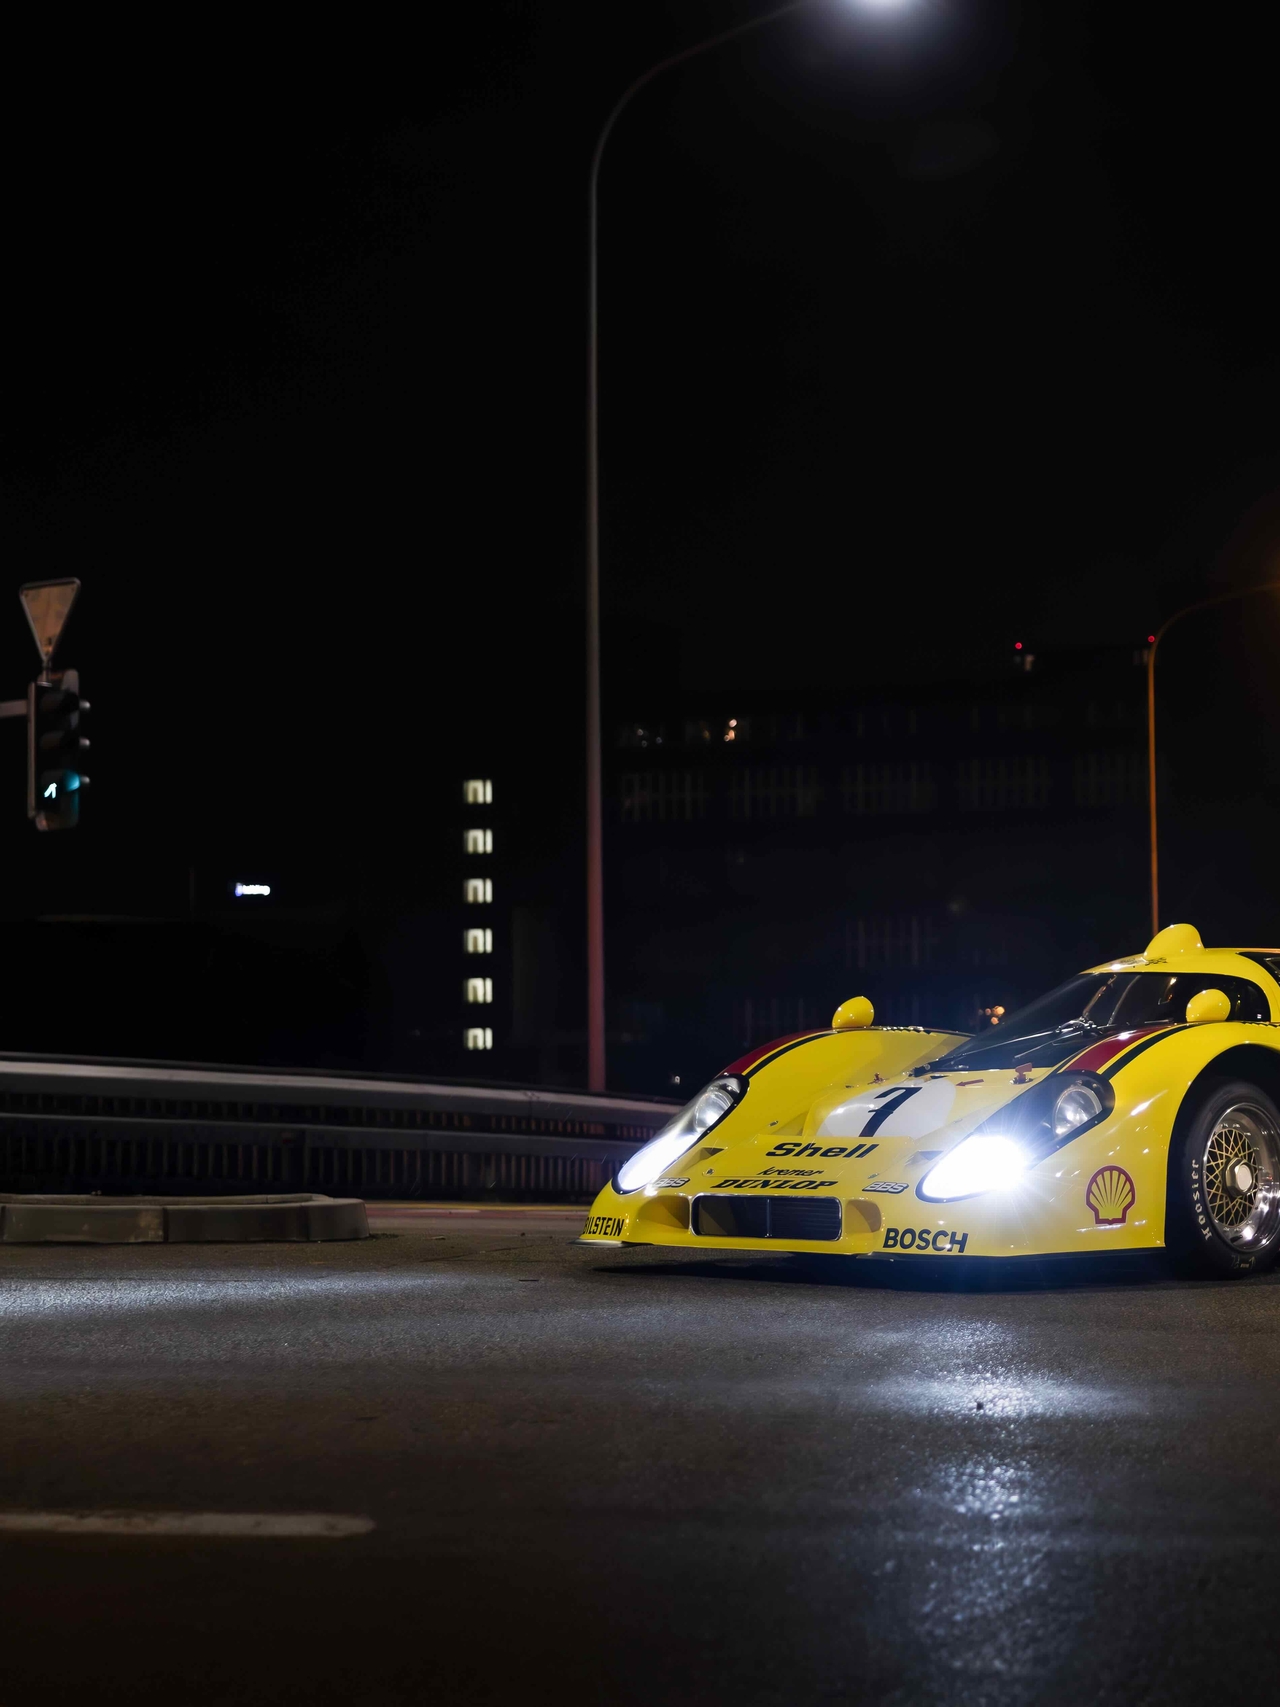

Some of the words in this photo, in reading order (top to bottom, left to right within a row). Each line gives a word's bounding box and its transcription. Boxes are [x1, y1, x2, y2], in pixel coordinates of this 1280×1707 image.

[765, 1142, 880, 1159] Shell
[757, 1166, 825, 1177] kremer
[653, 1177, 691, 1188] BBS
[710, 1178, 839, 1190] DUNLOP
[862, 1181, 909, 1194] BBS
[883, 1227, 969, 1253] BOSCH
